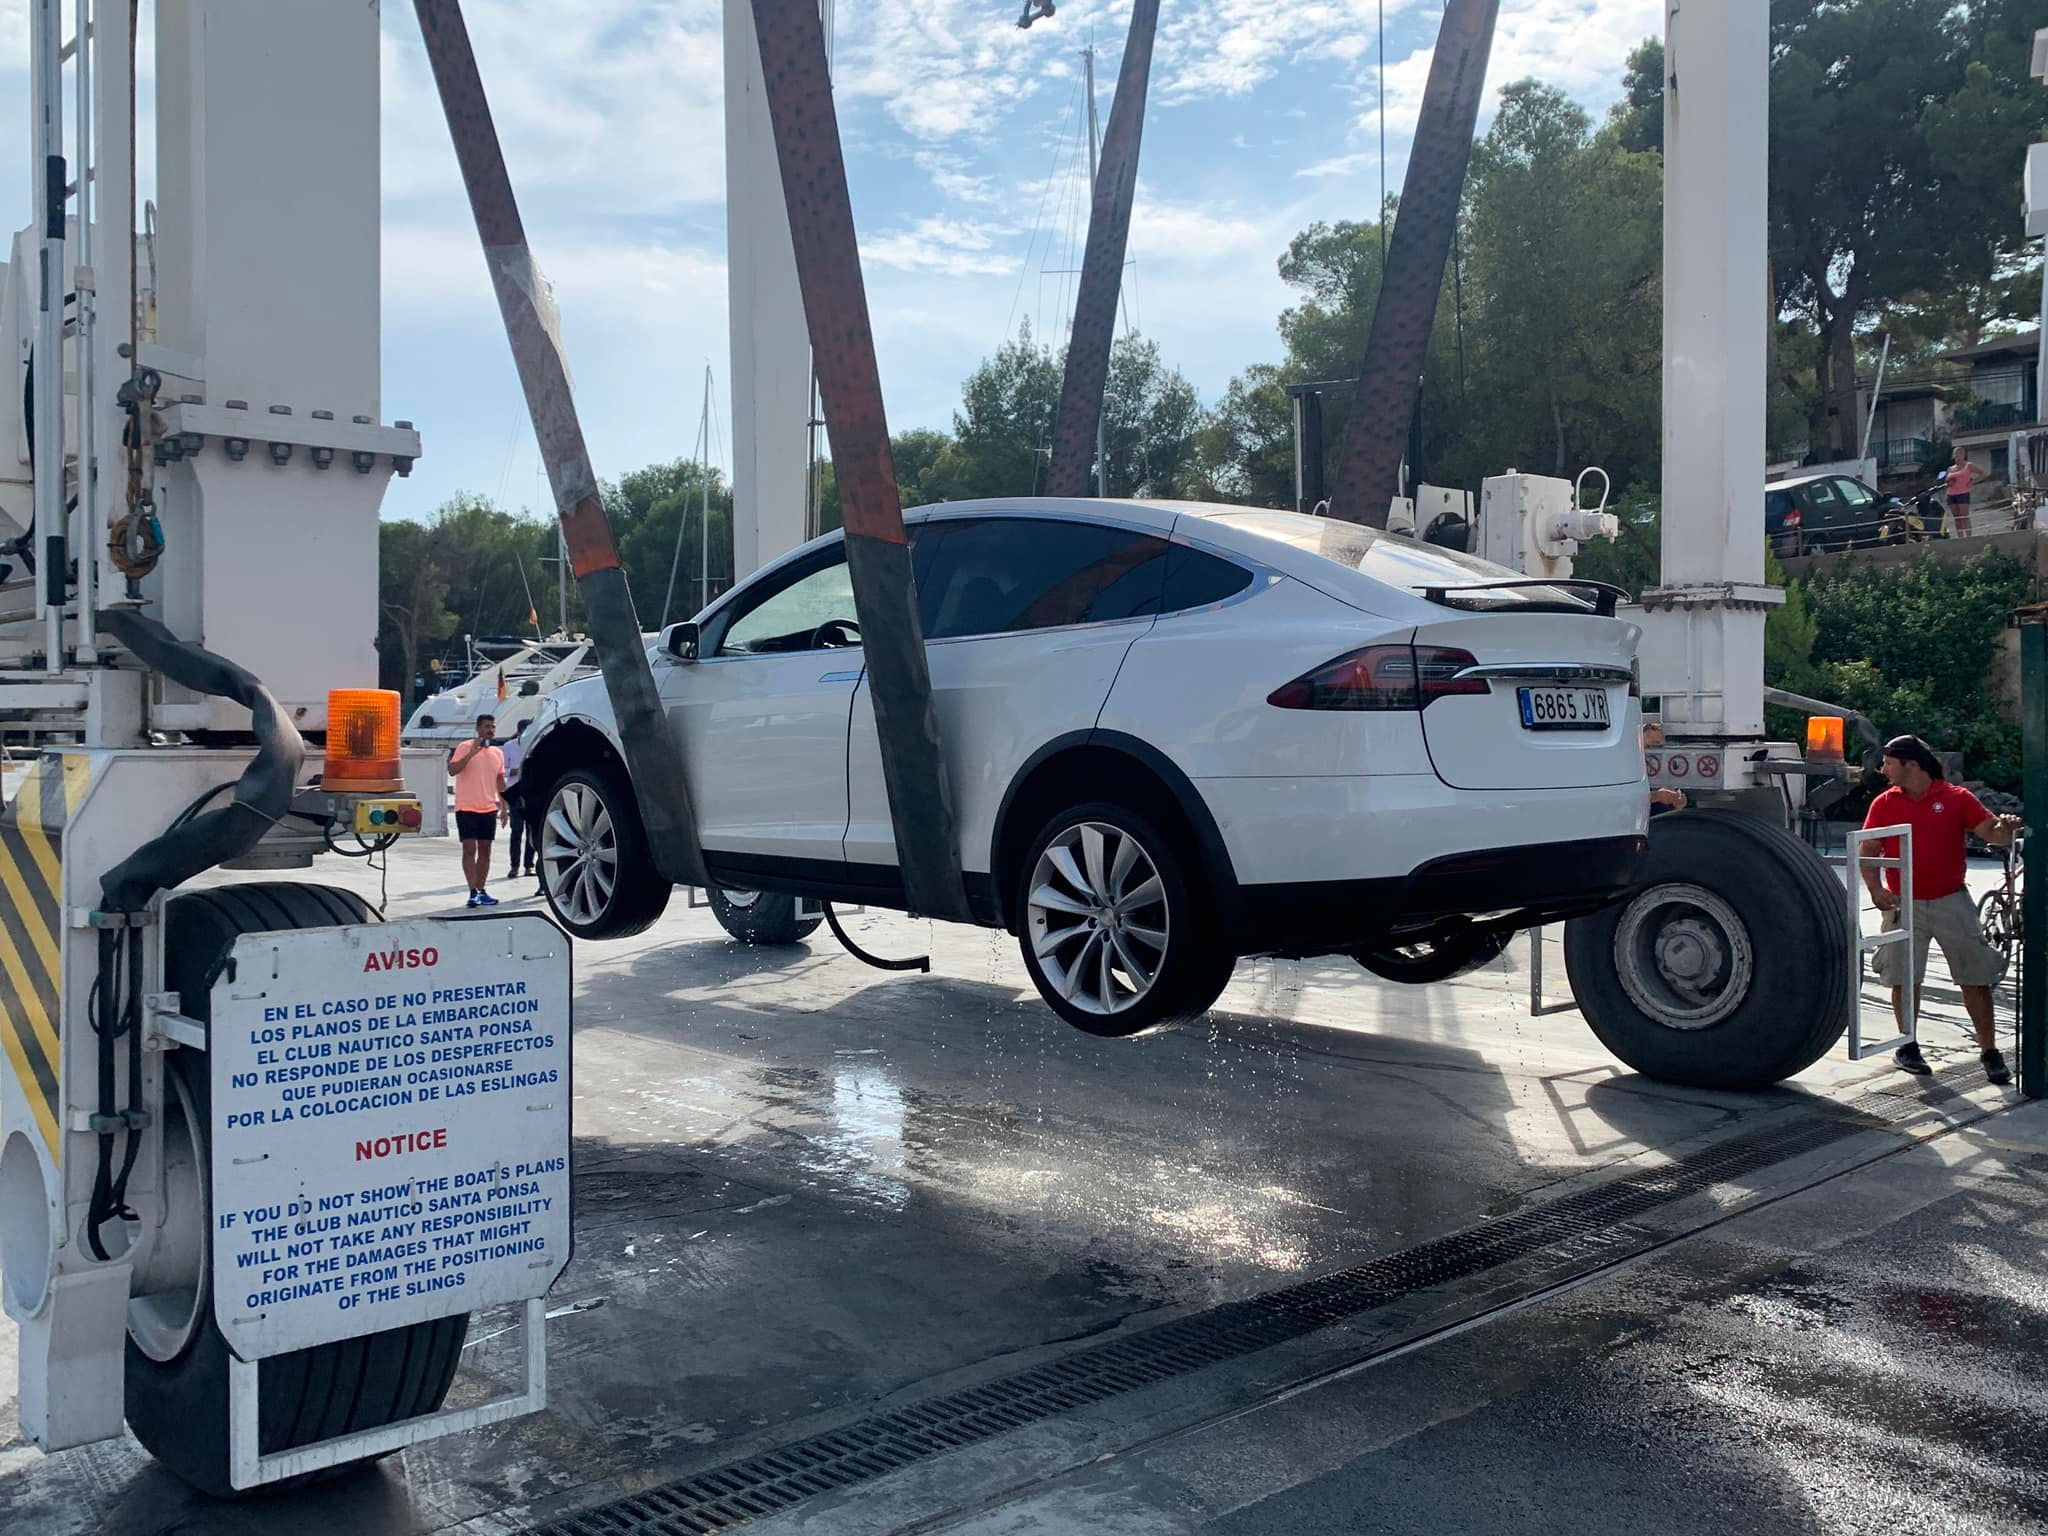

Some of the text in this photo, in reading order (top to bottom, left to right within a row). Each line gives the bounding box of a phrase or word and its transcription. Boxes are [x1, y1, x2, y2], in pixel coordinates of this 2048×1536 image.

[1534, 693, 1607, 720] 6865 JYR
[363, 947, 439, 973] AVISO
[251, 999, 538, 1044] LOS PLANOS DE LA EMBARCACION
[264, 981, 526, 1022] EN EL CASO DE NO PRESENTAR
[232, 1035, 554, 1088] NO RESPONDE DE LOS DESPERFECTOS
[257, 1019, 533, 1065] EL CLUB NAUTICO SANTA PONSA
[227, 1069, 558, 1128] POR LA COLOCACION DE LAS ESLINGAS
[282, 1059, 513, 1102] QUE PUDIERAN OCASIONARSE
[355, 1128, 447, 1161] NOTICE
[220, 1213, 237, 1229] IF
[243, 1205, 281, 1224] YOU
[287, 1200, 312, 1217] DO
[319, 1193, 355, 1211] NOT
[360, 1183, 411, 1204] SHOW
[416, 1177, 448, 1194] THE
[515, 1157, 565, 1178] PLANS
[251, 1181, 540, 1244] THE CLUB NAUTICO SANTA PONSA
[237, 1197, 552, 1268] WILL NOT TAKE ANY RESPONSIBILITY
[262, 1220, 531, 1284] FOR THE DAMAGES THAT MIGHT
[246, 1237, 545, 1308] ORIGINATE FROM THE POSITIONING
[338, 1272, 465, 1310] OF THE SLINGS
